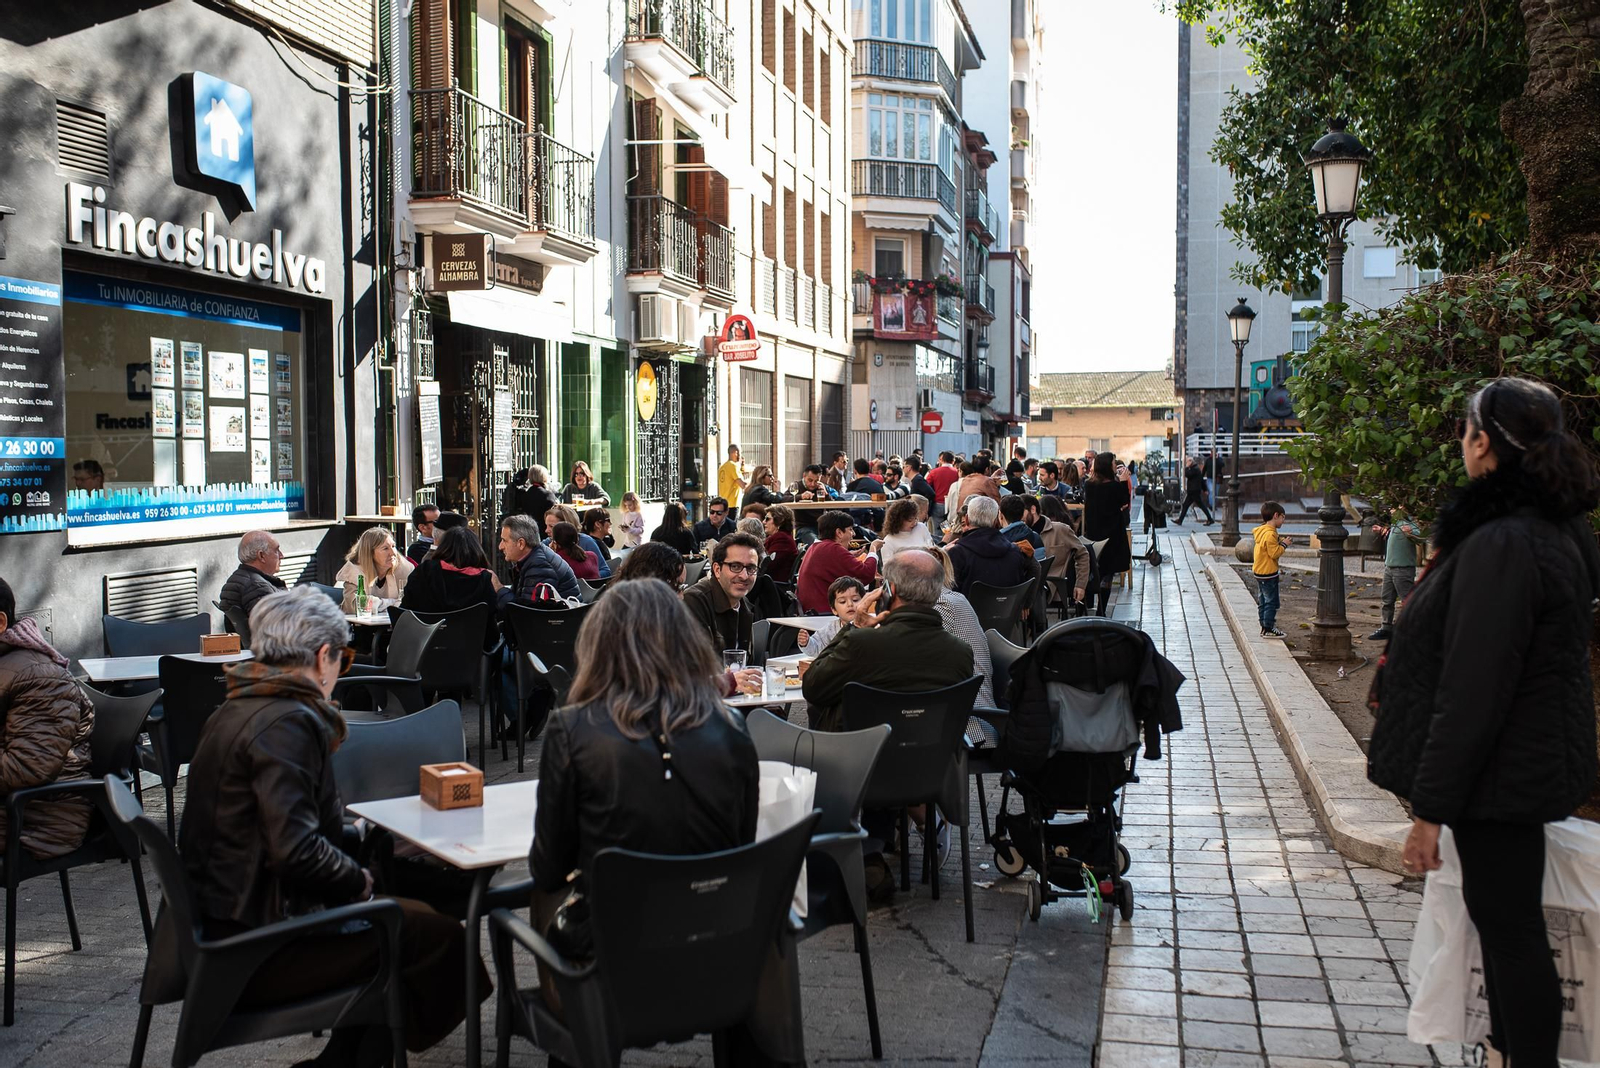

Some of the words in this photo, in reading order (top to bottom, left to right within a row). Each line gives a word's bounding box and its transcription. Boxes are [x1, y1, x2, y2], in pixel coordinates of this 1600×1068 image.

[66, 182, 326, 293] Fincashuelva
[441, 261, 477, 271] CERVEZAS
[439, 271, 479, 282] ALHAMBRA
[8, 282, 59, 298] Inmobiliarios
[98, 284, 110, 299] Tu
[113, 286, 189, 311] INMOBILIARIA
[190, 298, 202, 313] de
[204, 301, 259, 321] CONFIANZA
[2, 362, 26, 370] Alquileres
[35, 398, 54, 407] Chalets
[24, 414, 44, 424] Locales
[5, 440, 21, 455] 26
[23, 440, 38, 455] 30
[40, 440, 55, 455] 00
[12, 478, 22, 487] 34
[23, 477, 33, 487] 07
[34, 477, 42, 487] 01
[144, 508, 158, 519] 959
[159, 507, 169, 517] 26
[169, 506, 179, 516] 30
[179, 505, 189, 516] 00
[193, 504, 206, 515] 675
[206, 503, 216, 514] 34
[216, 503, 225, 513] 07
[225, 502, 233, 512] 01
